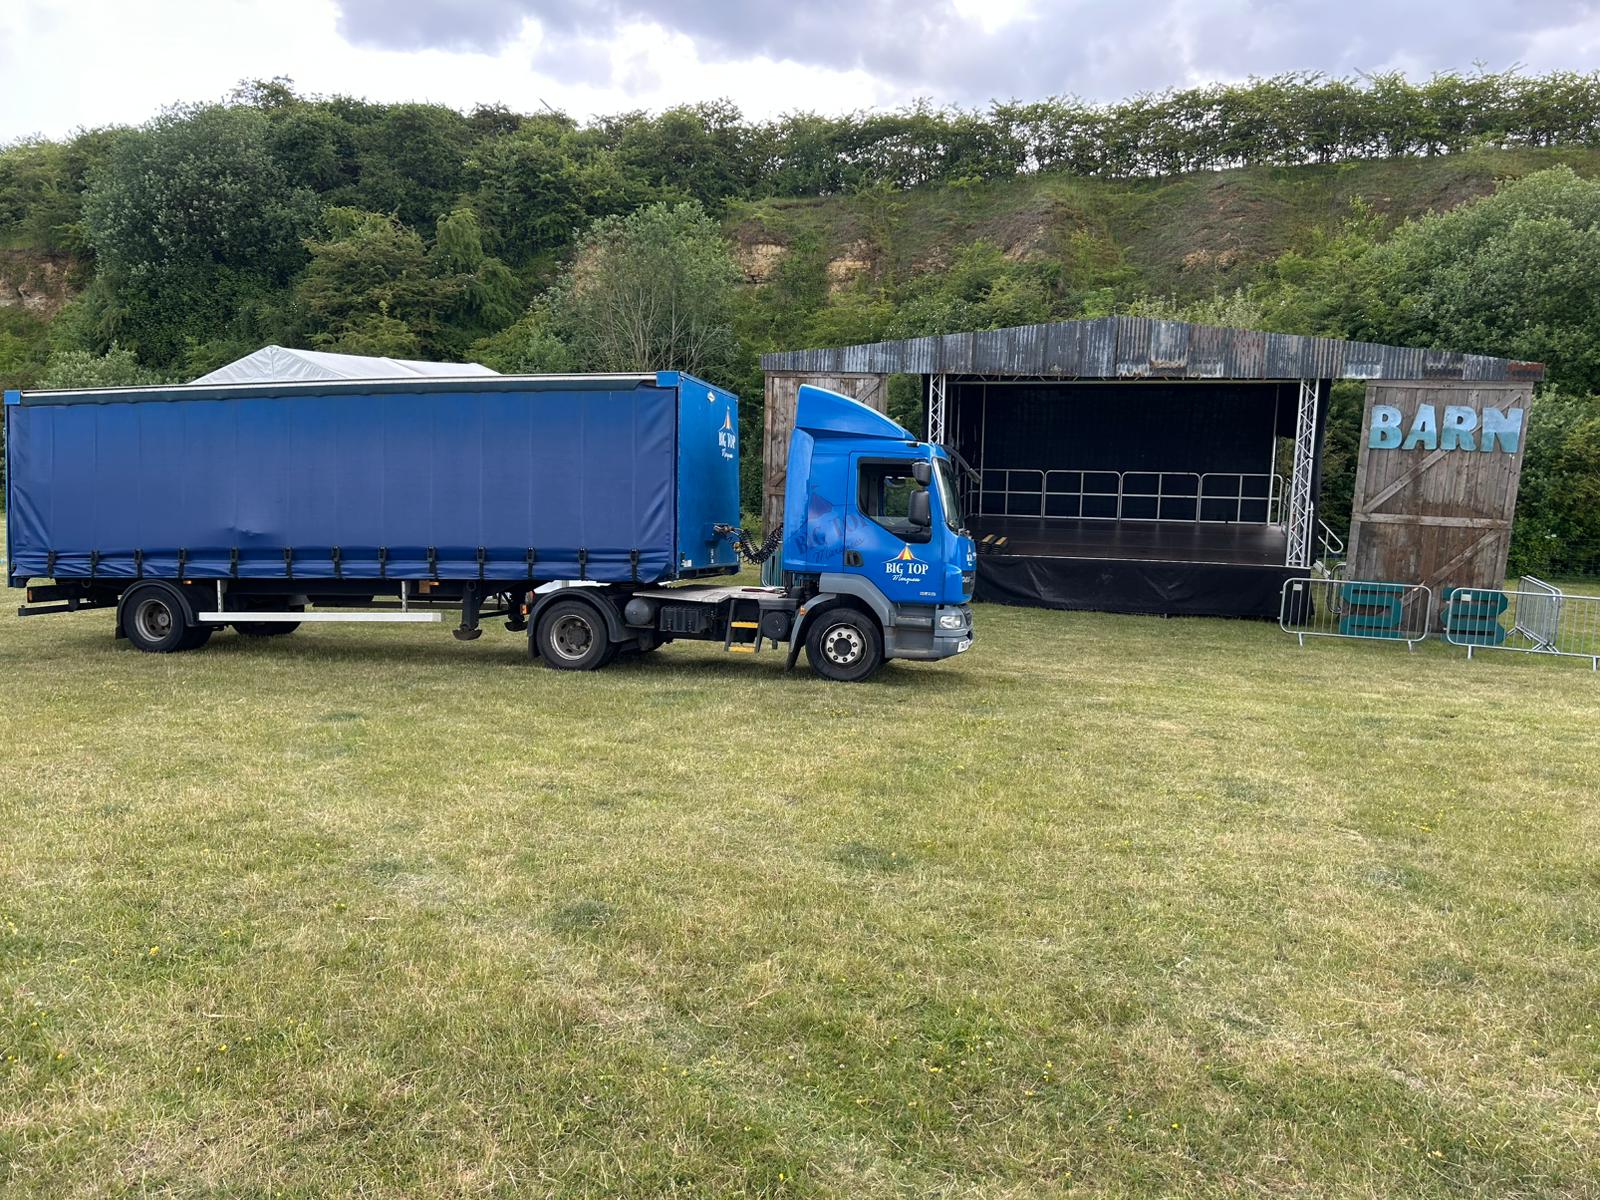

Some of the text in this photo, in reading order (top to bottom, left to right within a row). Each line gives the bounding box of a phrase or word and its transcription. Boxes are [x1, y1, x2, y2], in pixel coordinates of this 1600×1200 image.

[1368, 403, 1524, 453] BARN
[885, 562, 929, 575] BIG TOP
